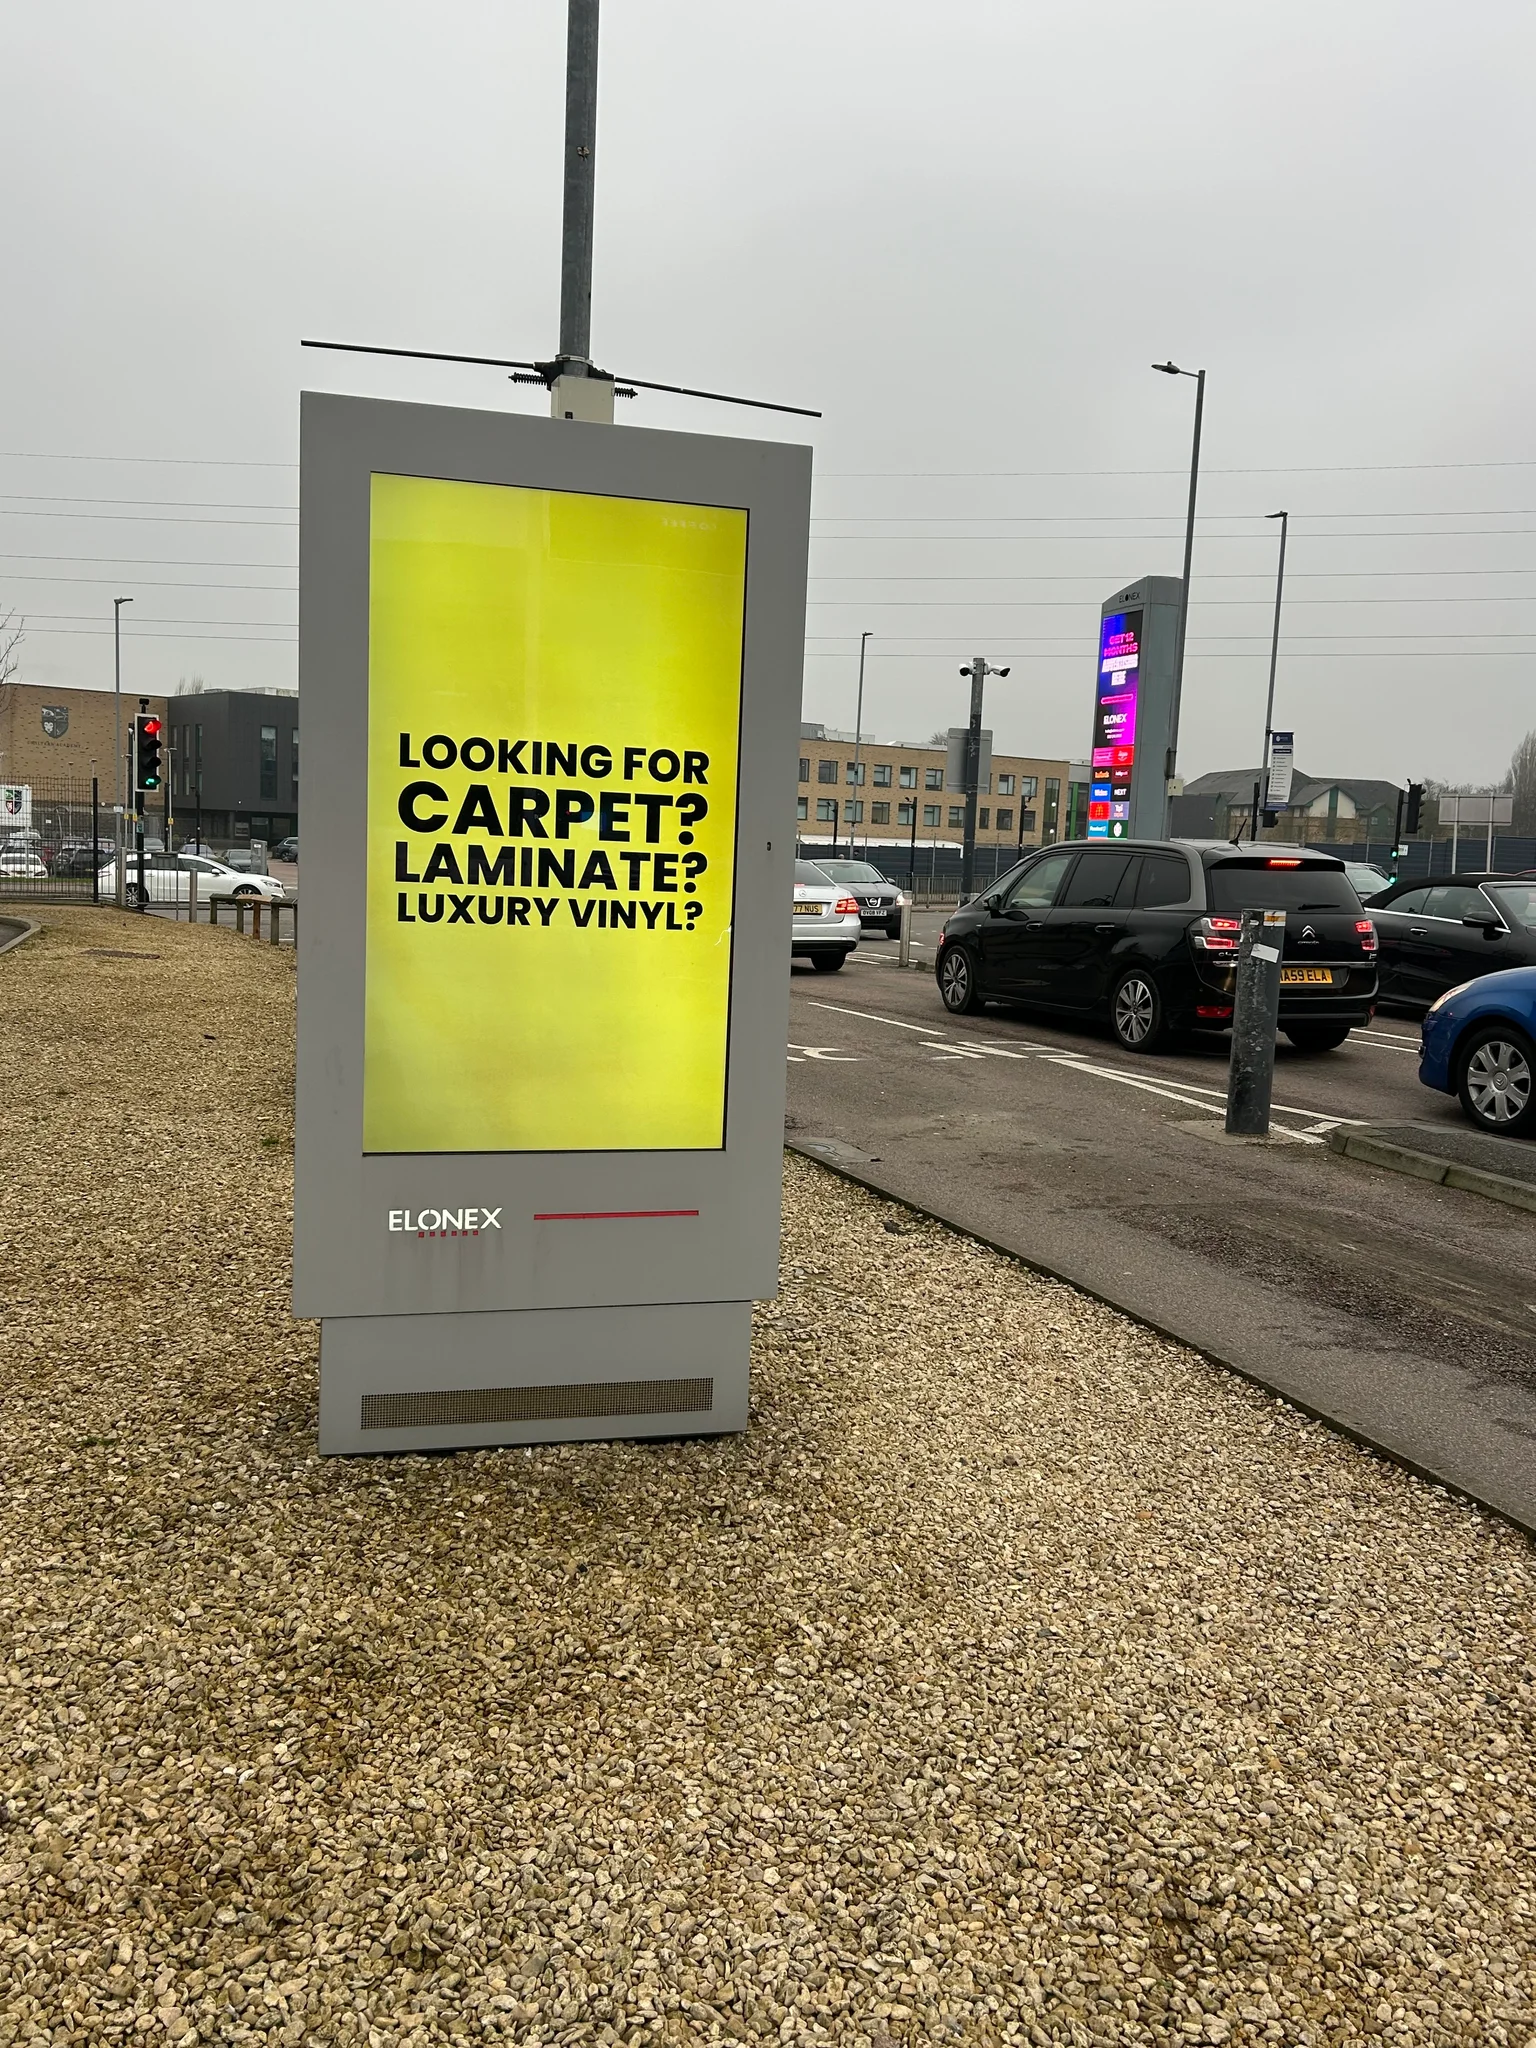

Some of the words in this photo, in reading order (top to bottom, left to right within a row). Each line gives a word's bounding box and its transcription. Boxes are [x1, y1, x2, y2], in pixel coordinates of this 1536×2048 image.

[1118, 592, 1140, 604] ELONEX
[1103, 642, 1138, 658] MONTHS
[1104, 713, 1127, 725] ELONEX
[399, 732, 615, 781] LOOKING
[624, 746, 712, 787] FOR
[398, 780, 710, 847] CARPET?
[395, 841, 710, 897] LAMINATE?
[398, 892, 562, 929] LUXURY
[568, 898, 705, 933] VINYL?
[804, 904, 820, 914] NUS
[1307, 969, 1328, 982] ELA
[388, 1207, 504, 1232] ELONEX
